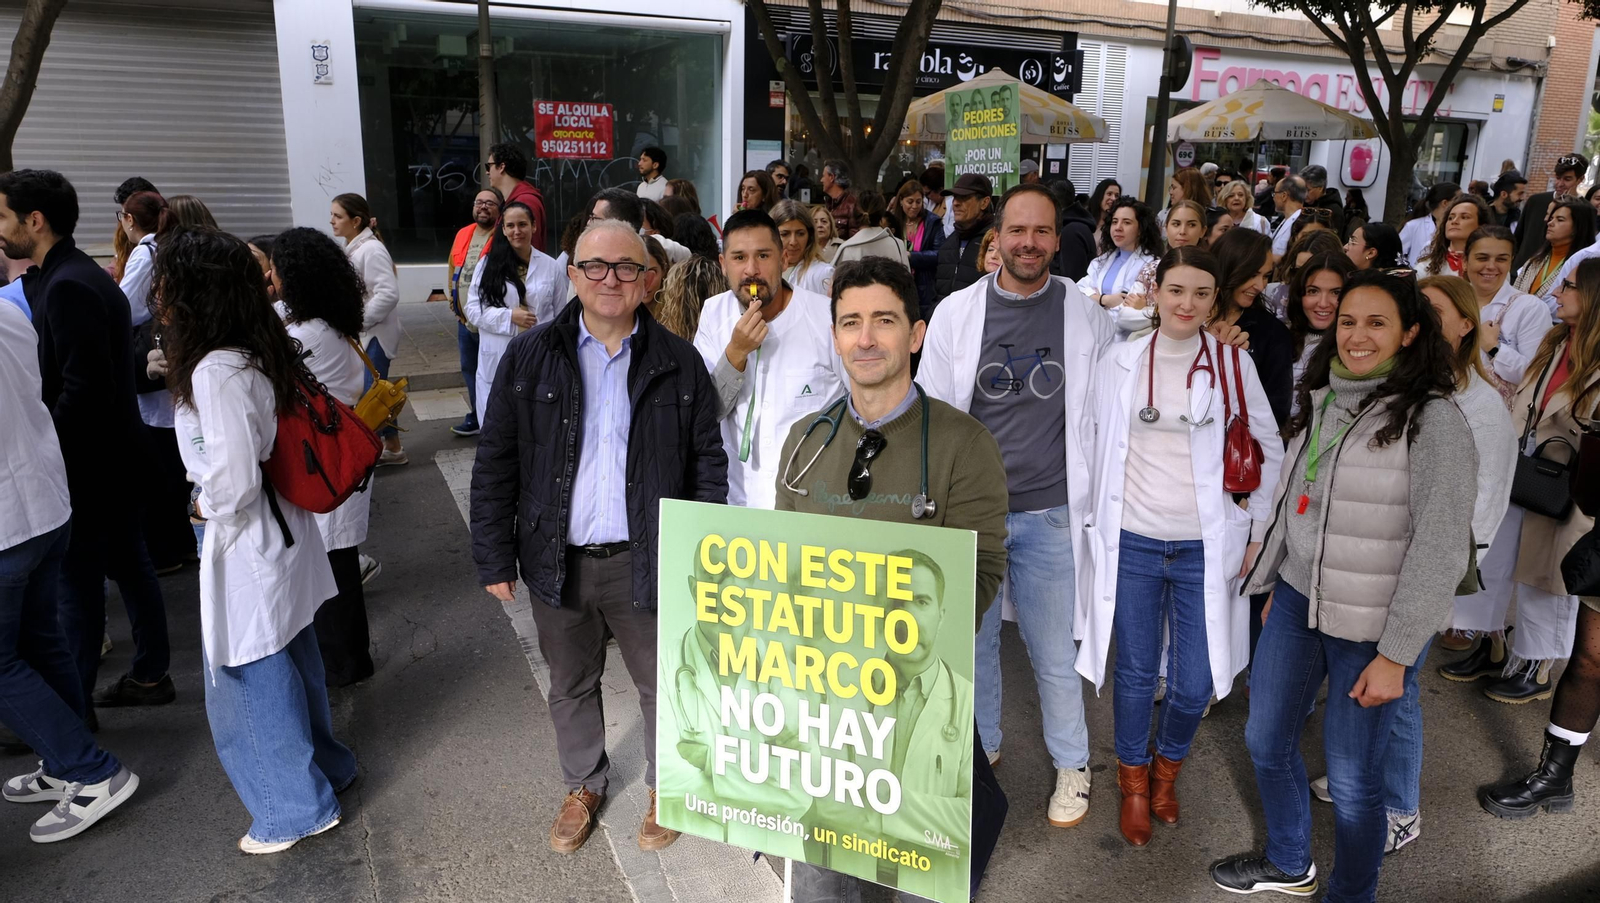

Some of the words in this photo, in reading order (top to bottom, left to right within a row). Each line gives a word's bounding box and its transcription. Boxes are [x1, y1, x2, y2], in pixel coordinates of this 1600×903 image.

[873, 48, 953, 74] rabla
[1053, 83, 1070, 91] Coffee
[538, 102, 554, 115] SE
[557, 104, 609, 117] ALQUILA
[963, 107, 1005, 125] PEORES
[555, 115, 594, 128] LOCAL
[951, 123, 1017, 141] CONDICIONES
[1050, 125, 1080, 136] BLISS
[1203, 130, 1236, 138] BLISS
[1286, 130, 1318, 138] BLISS
[541, 139, 607, 154] 950251112
[965, 149, 986, 163] ¡POR
[988, 147, 1002, 160] UN
[955, 163, 986, 176] MARCO
[987, 161, 1014, 174] LEGAL
[700, 533, 788, 584] CON
[800, 544, 914, 602] ESTE
[696, 581, 920, 655] ESTATUTO
[718, 632, 897, 706] MARCO
[720, 684, 786, 737] NO
[798, 698, 897, 760] HAY
[715, 733, 903, 815] FUTURO
[685, 792, 718, 817] Una
[722, 802, 810, 841] profesión,
[813, 826, 837, 846] un
[841, 832, 931, 872] sindicato
